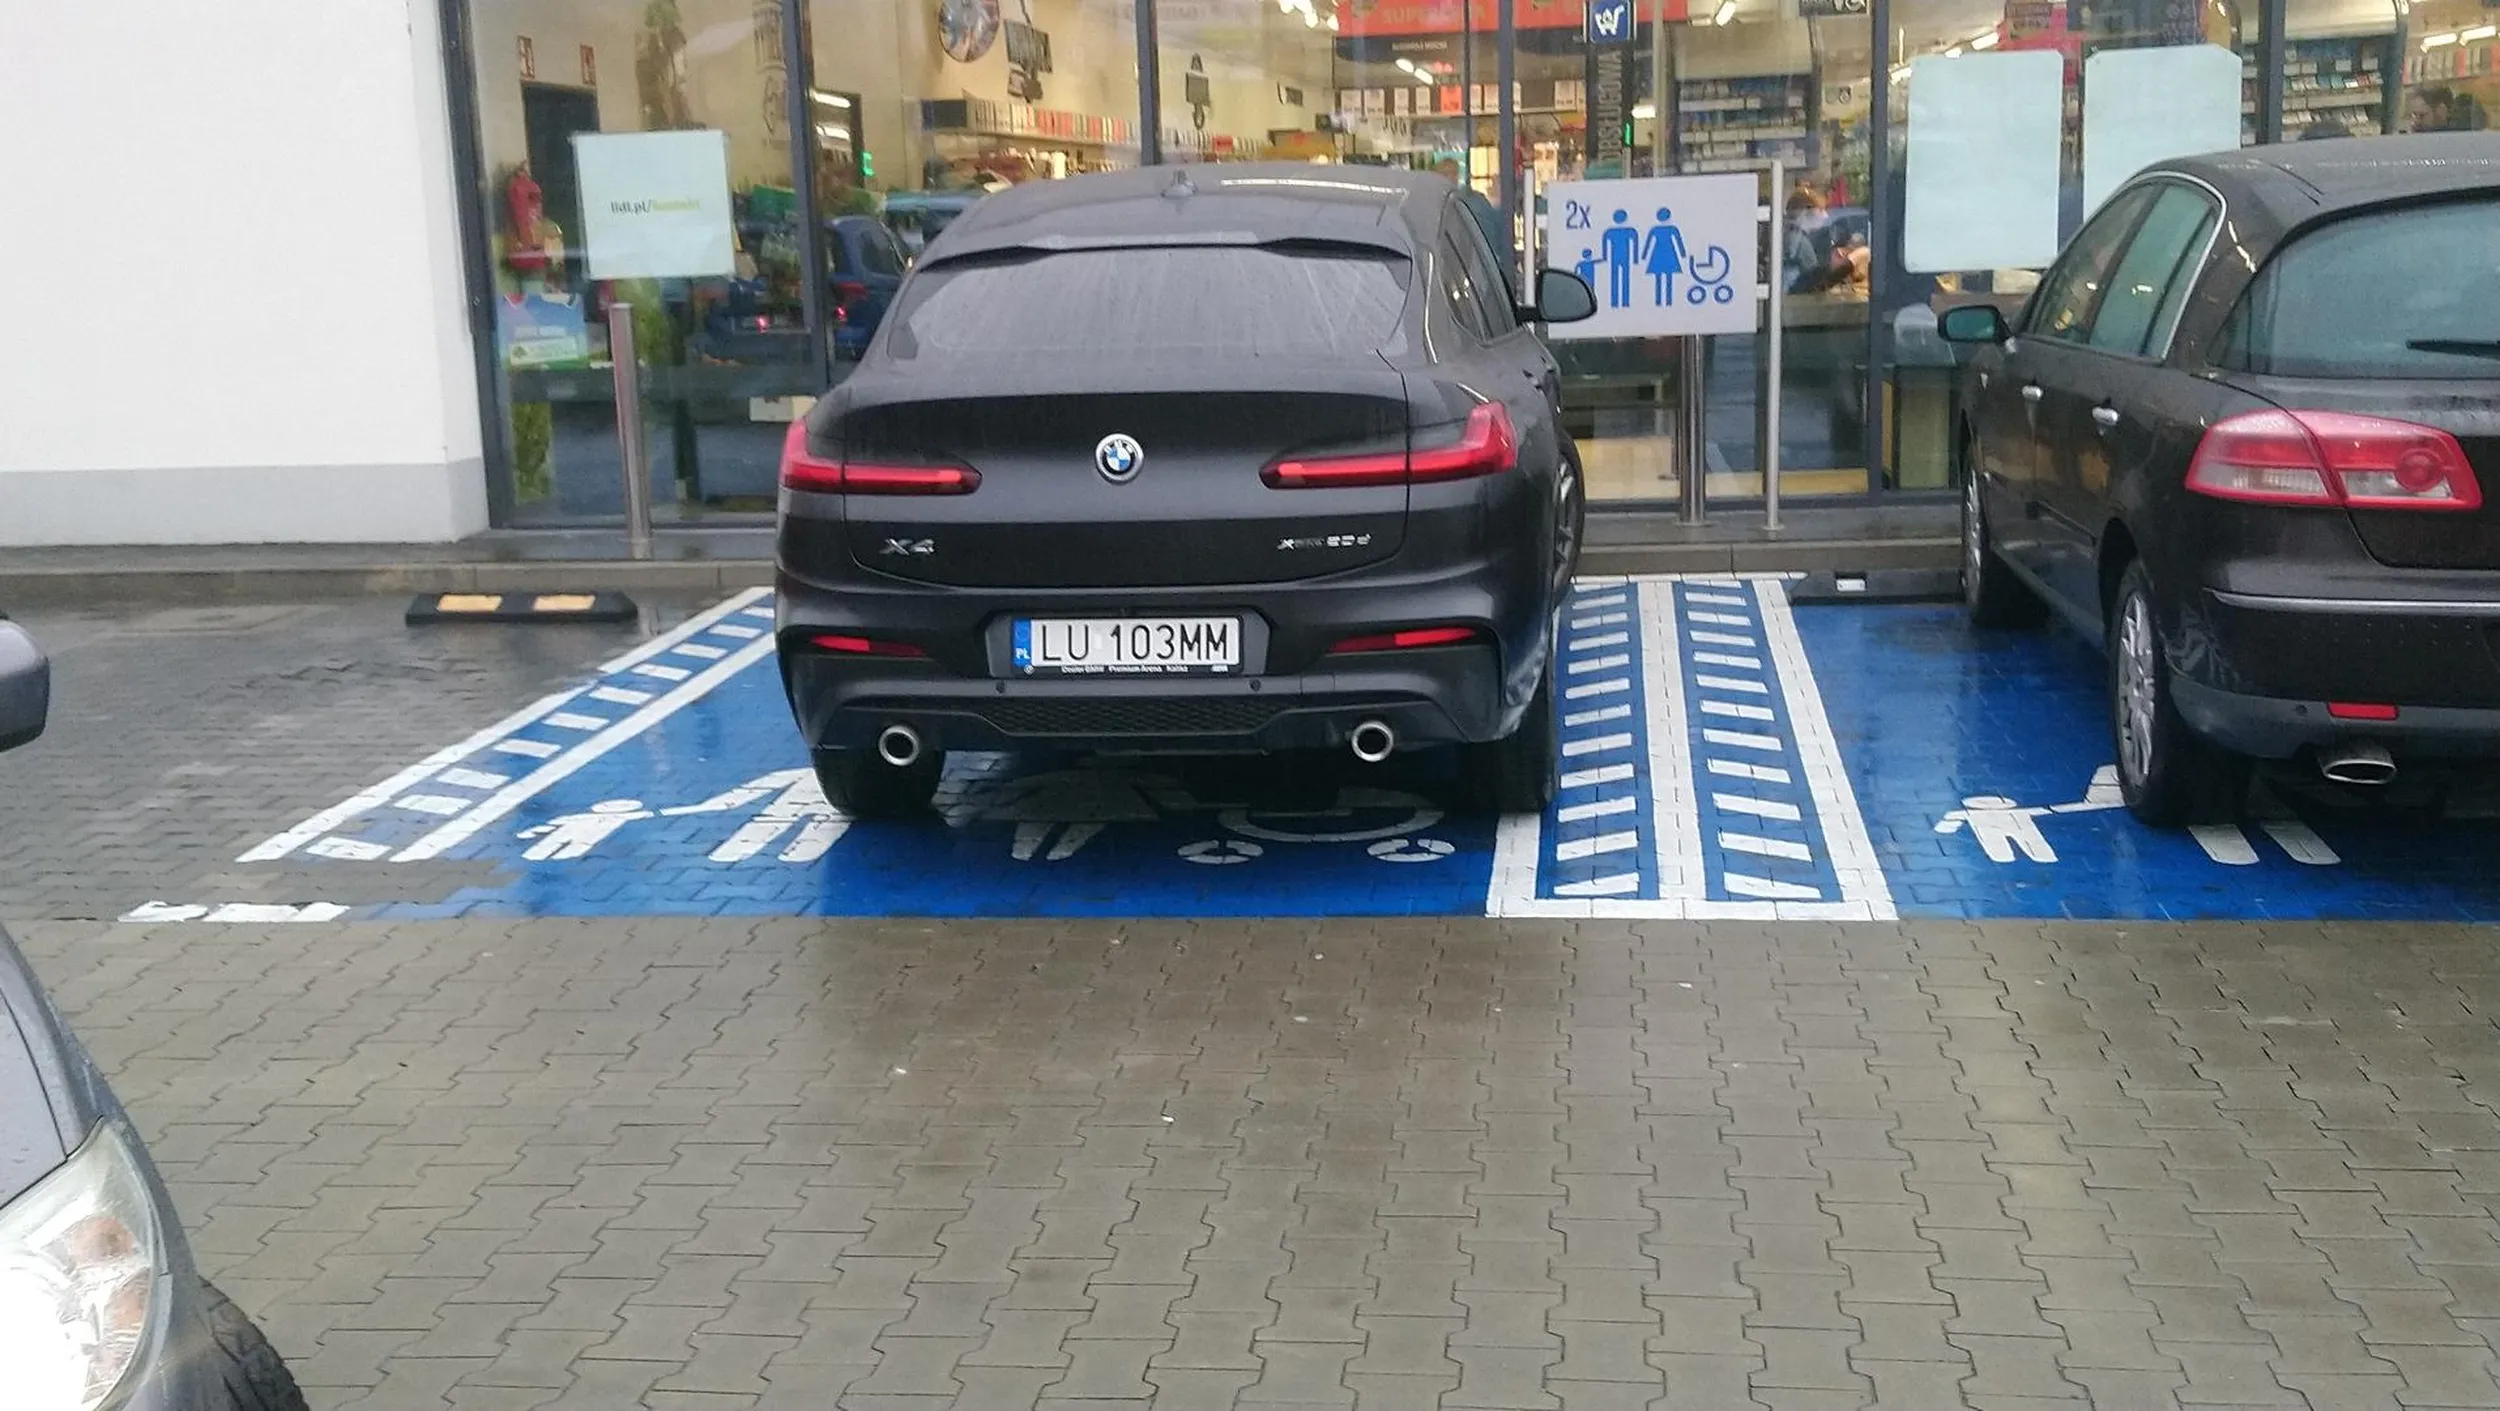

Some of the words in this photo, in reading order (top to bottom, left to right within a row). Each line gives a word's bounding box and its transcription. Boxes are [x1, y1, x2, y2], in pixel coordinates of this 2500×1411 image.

[1565, 199, 1592, 230] 2x
[880, 538, 936, 556] X4
[1016, 648, 1029, 660] PL
[1041, 624, 1089, 661] LU
[1110, 624, 1228, 660] 103MM
